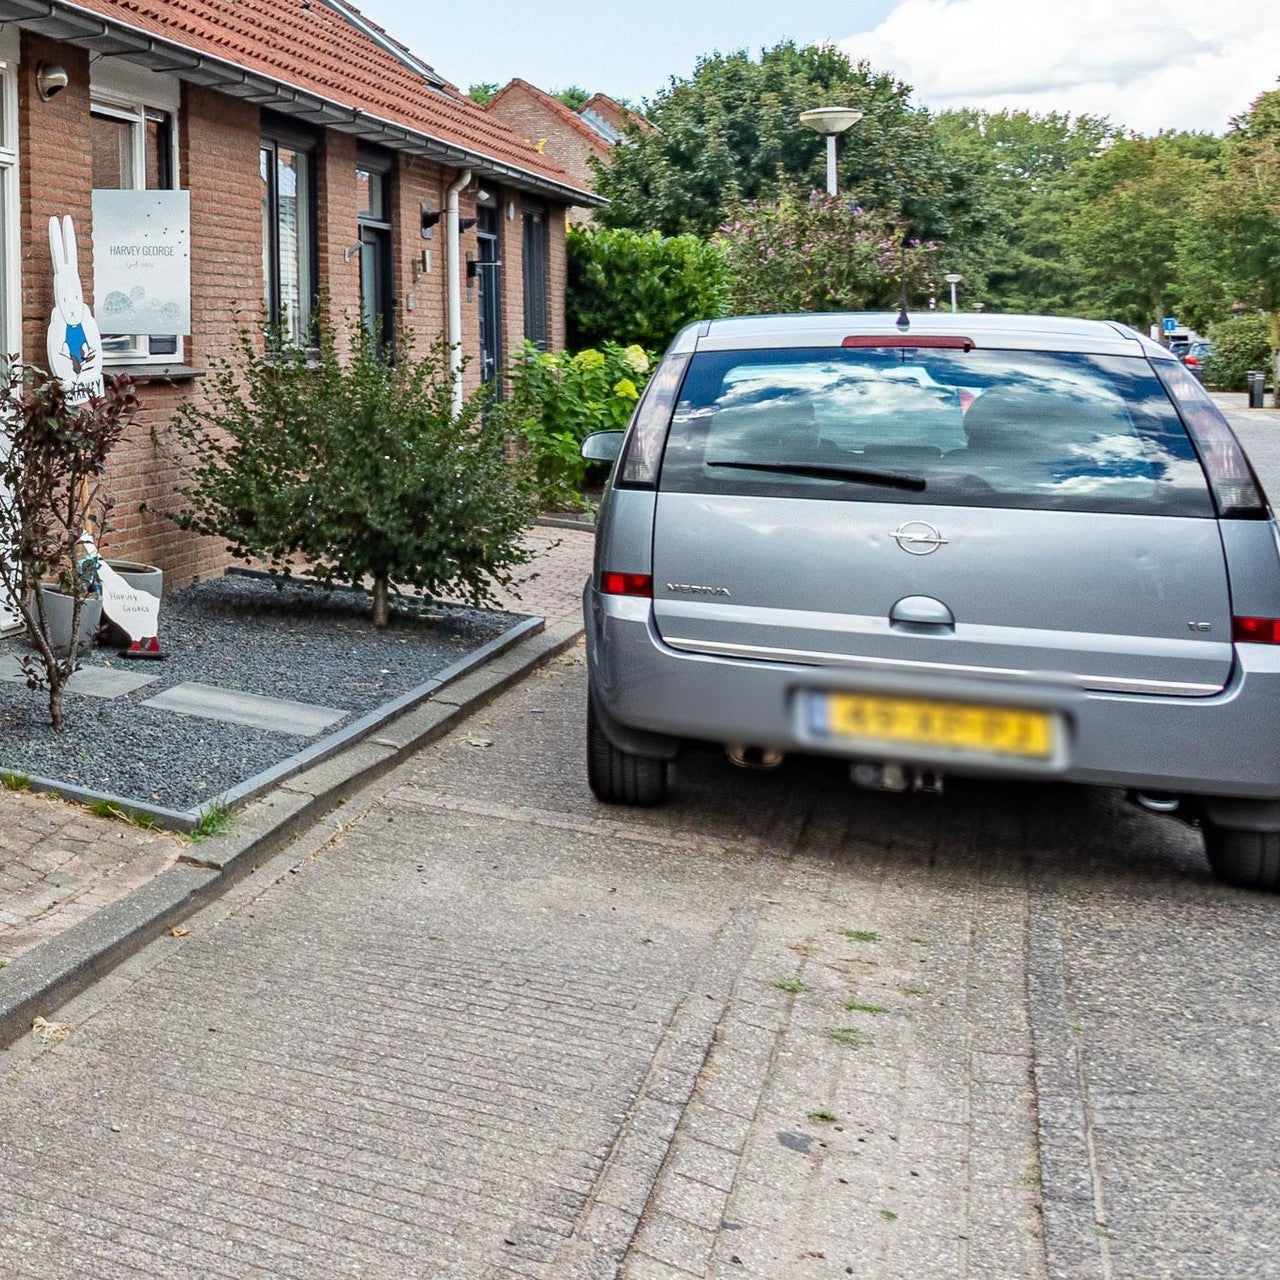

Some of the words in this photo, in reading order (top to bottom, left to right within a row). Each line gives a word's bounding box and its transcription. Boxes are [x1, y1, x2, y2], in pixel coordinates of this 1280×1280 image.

[110, 245, 140, 256] HARVEY
[142, 245, 175, 257] GEORGE
[666, 583, 731, 597] MERIVA
